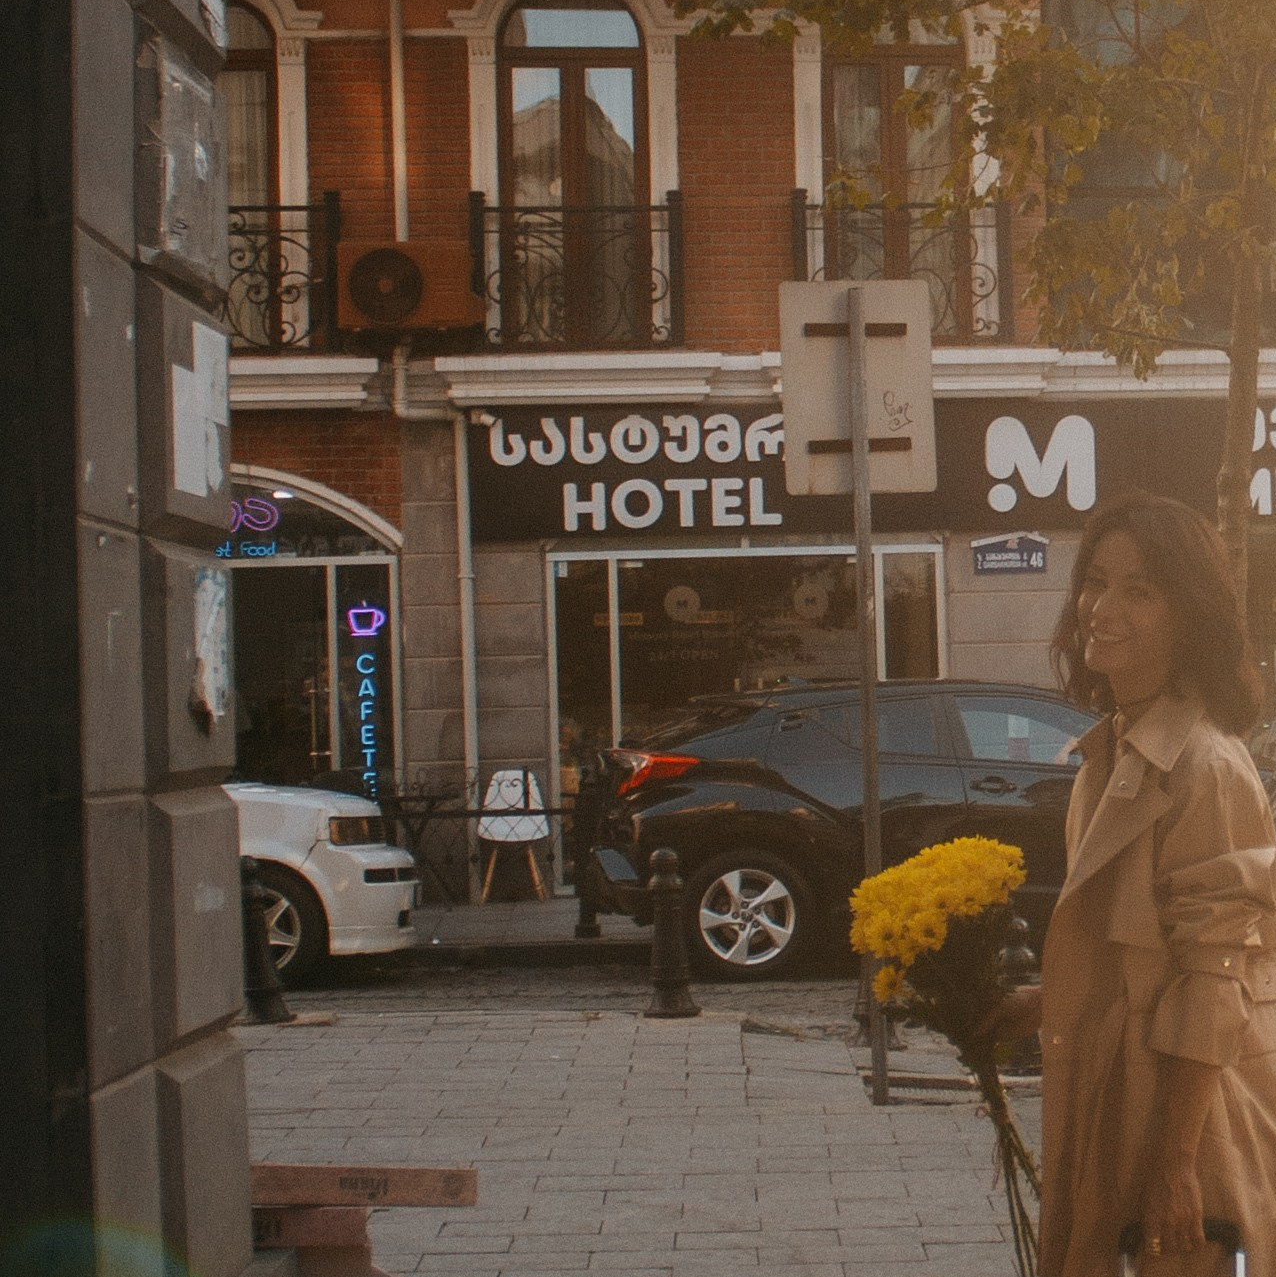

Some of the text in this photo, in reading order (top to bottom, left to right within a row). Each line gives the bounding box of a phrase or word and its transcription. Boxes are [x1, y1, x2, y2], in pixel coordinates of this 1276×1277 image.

[489, 413, 786, 466] სასტუმრ
[562, 477, 783, 531] HOTEL
[215, 540, 277, 558] st Food
[1029, 551, 1044, 567] 46
